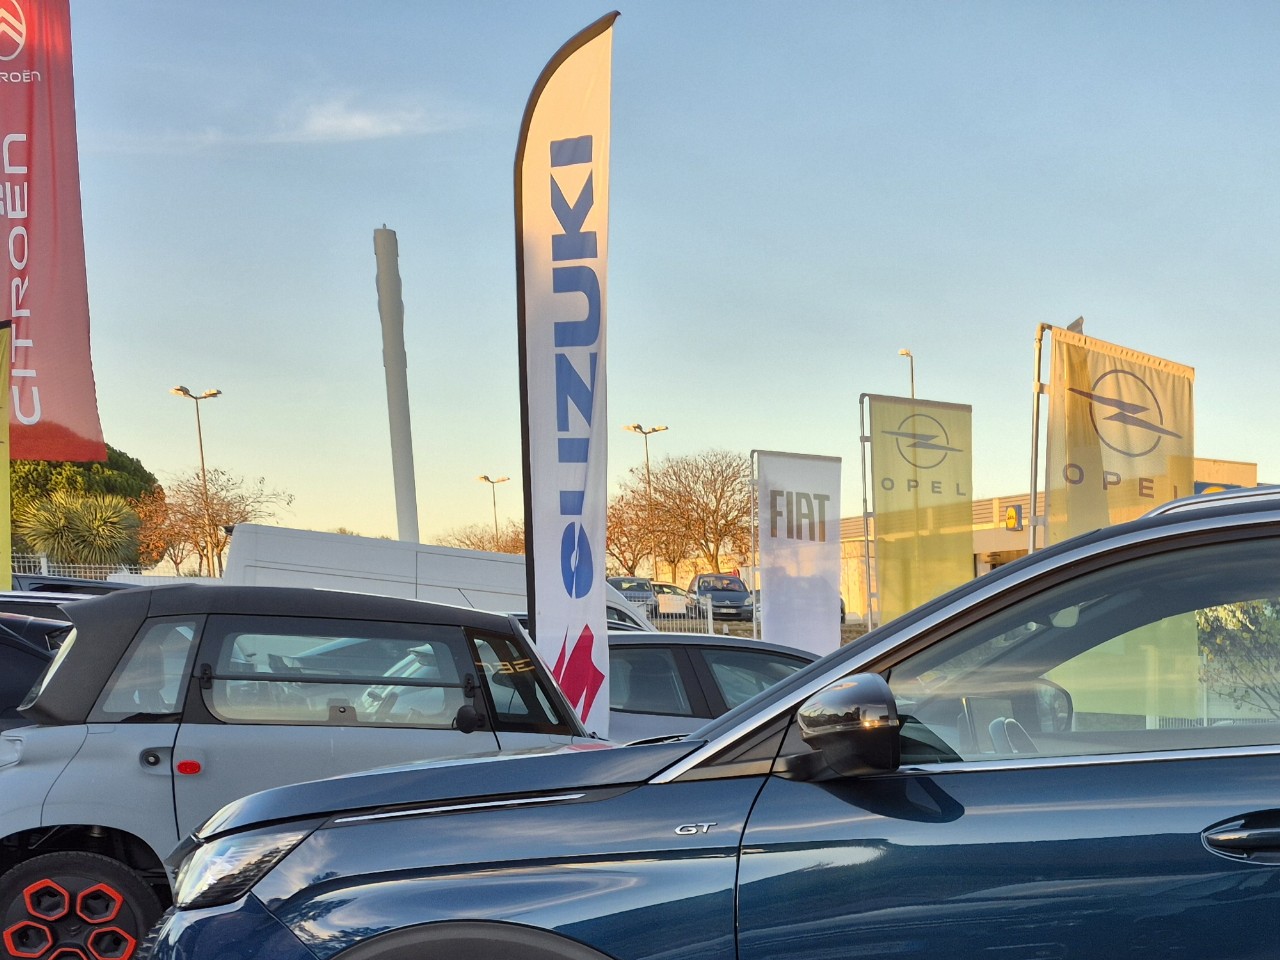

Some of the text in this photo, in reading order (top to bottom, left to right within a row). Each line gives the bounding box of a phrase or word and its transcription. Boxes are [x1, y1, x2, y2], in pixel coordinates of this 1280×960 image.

[880, 477, 967, 497] OPEL
[769, 489, 831, 543] FIAT
[674, 822, 718, 836] GT
